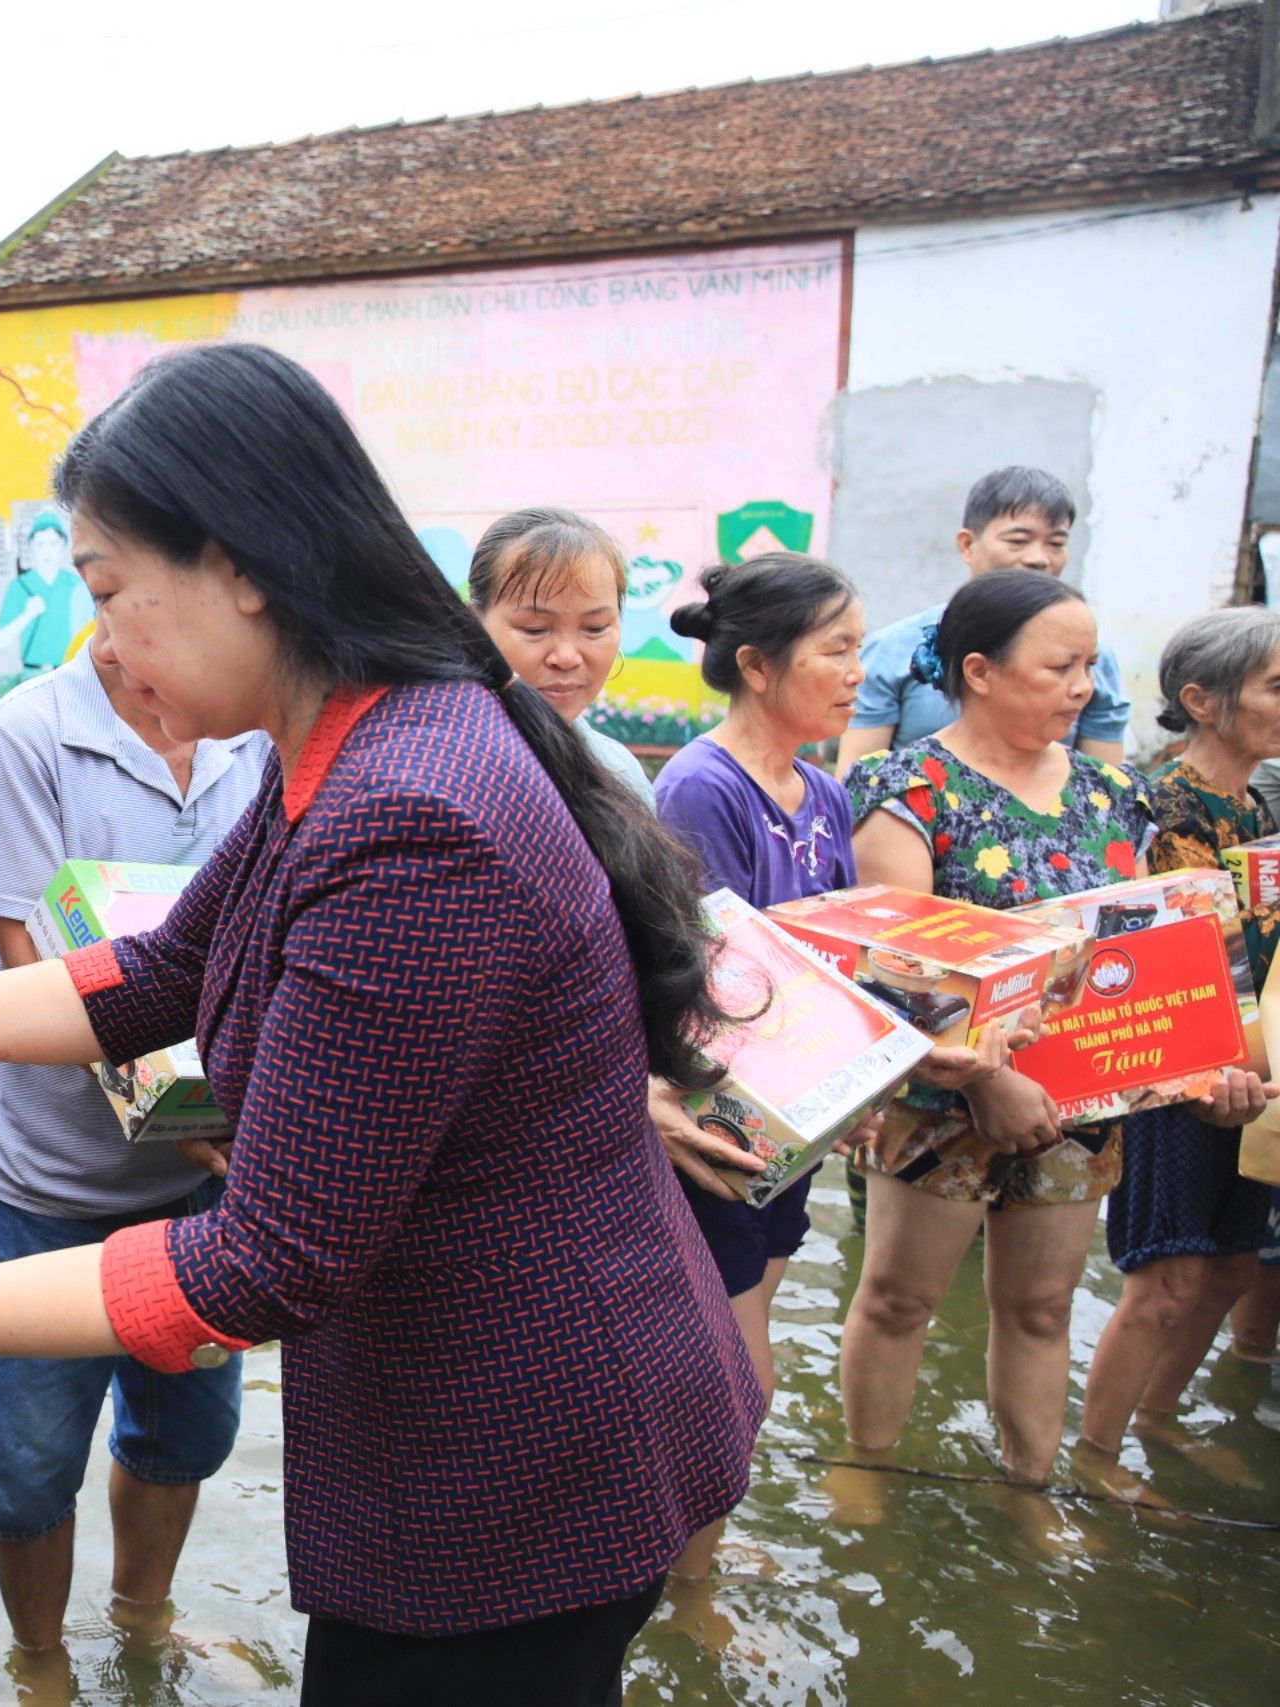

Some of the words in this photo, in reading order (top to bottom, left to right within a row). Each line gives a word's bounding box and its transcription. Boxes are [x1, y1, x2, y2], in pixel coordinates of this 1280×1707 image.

[536, 277, 600, 309] CÔNG
[1046, 1019, 1061, 1038] AN
[1063, 1015, 1087, 1034] MẶT
[1088, 1006, 1117, 1027] TRẬN
[1118, 1001, 1133, 1018] TỔ
[1135, 993, 1164, 1017] QUỐC
[1166, 988, 1190, 1010] VIỆT
[1190, 983, 1218, 1001] NAM
[1073, 1028, 1111, 1052] THÀNH
[1111, 1022, 1134, 1044] PHỐ
[1135, 1020, 1152, 1038] HÀ
[1153, 1015, 1174, 1036] NỘI
[1090, 1047, 1163, 1076] Tặng
